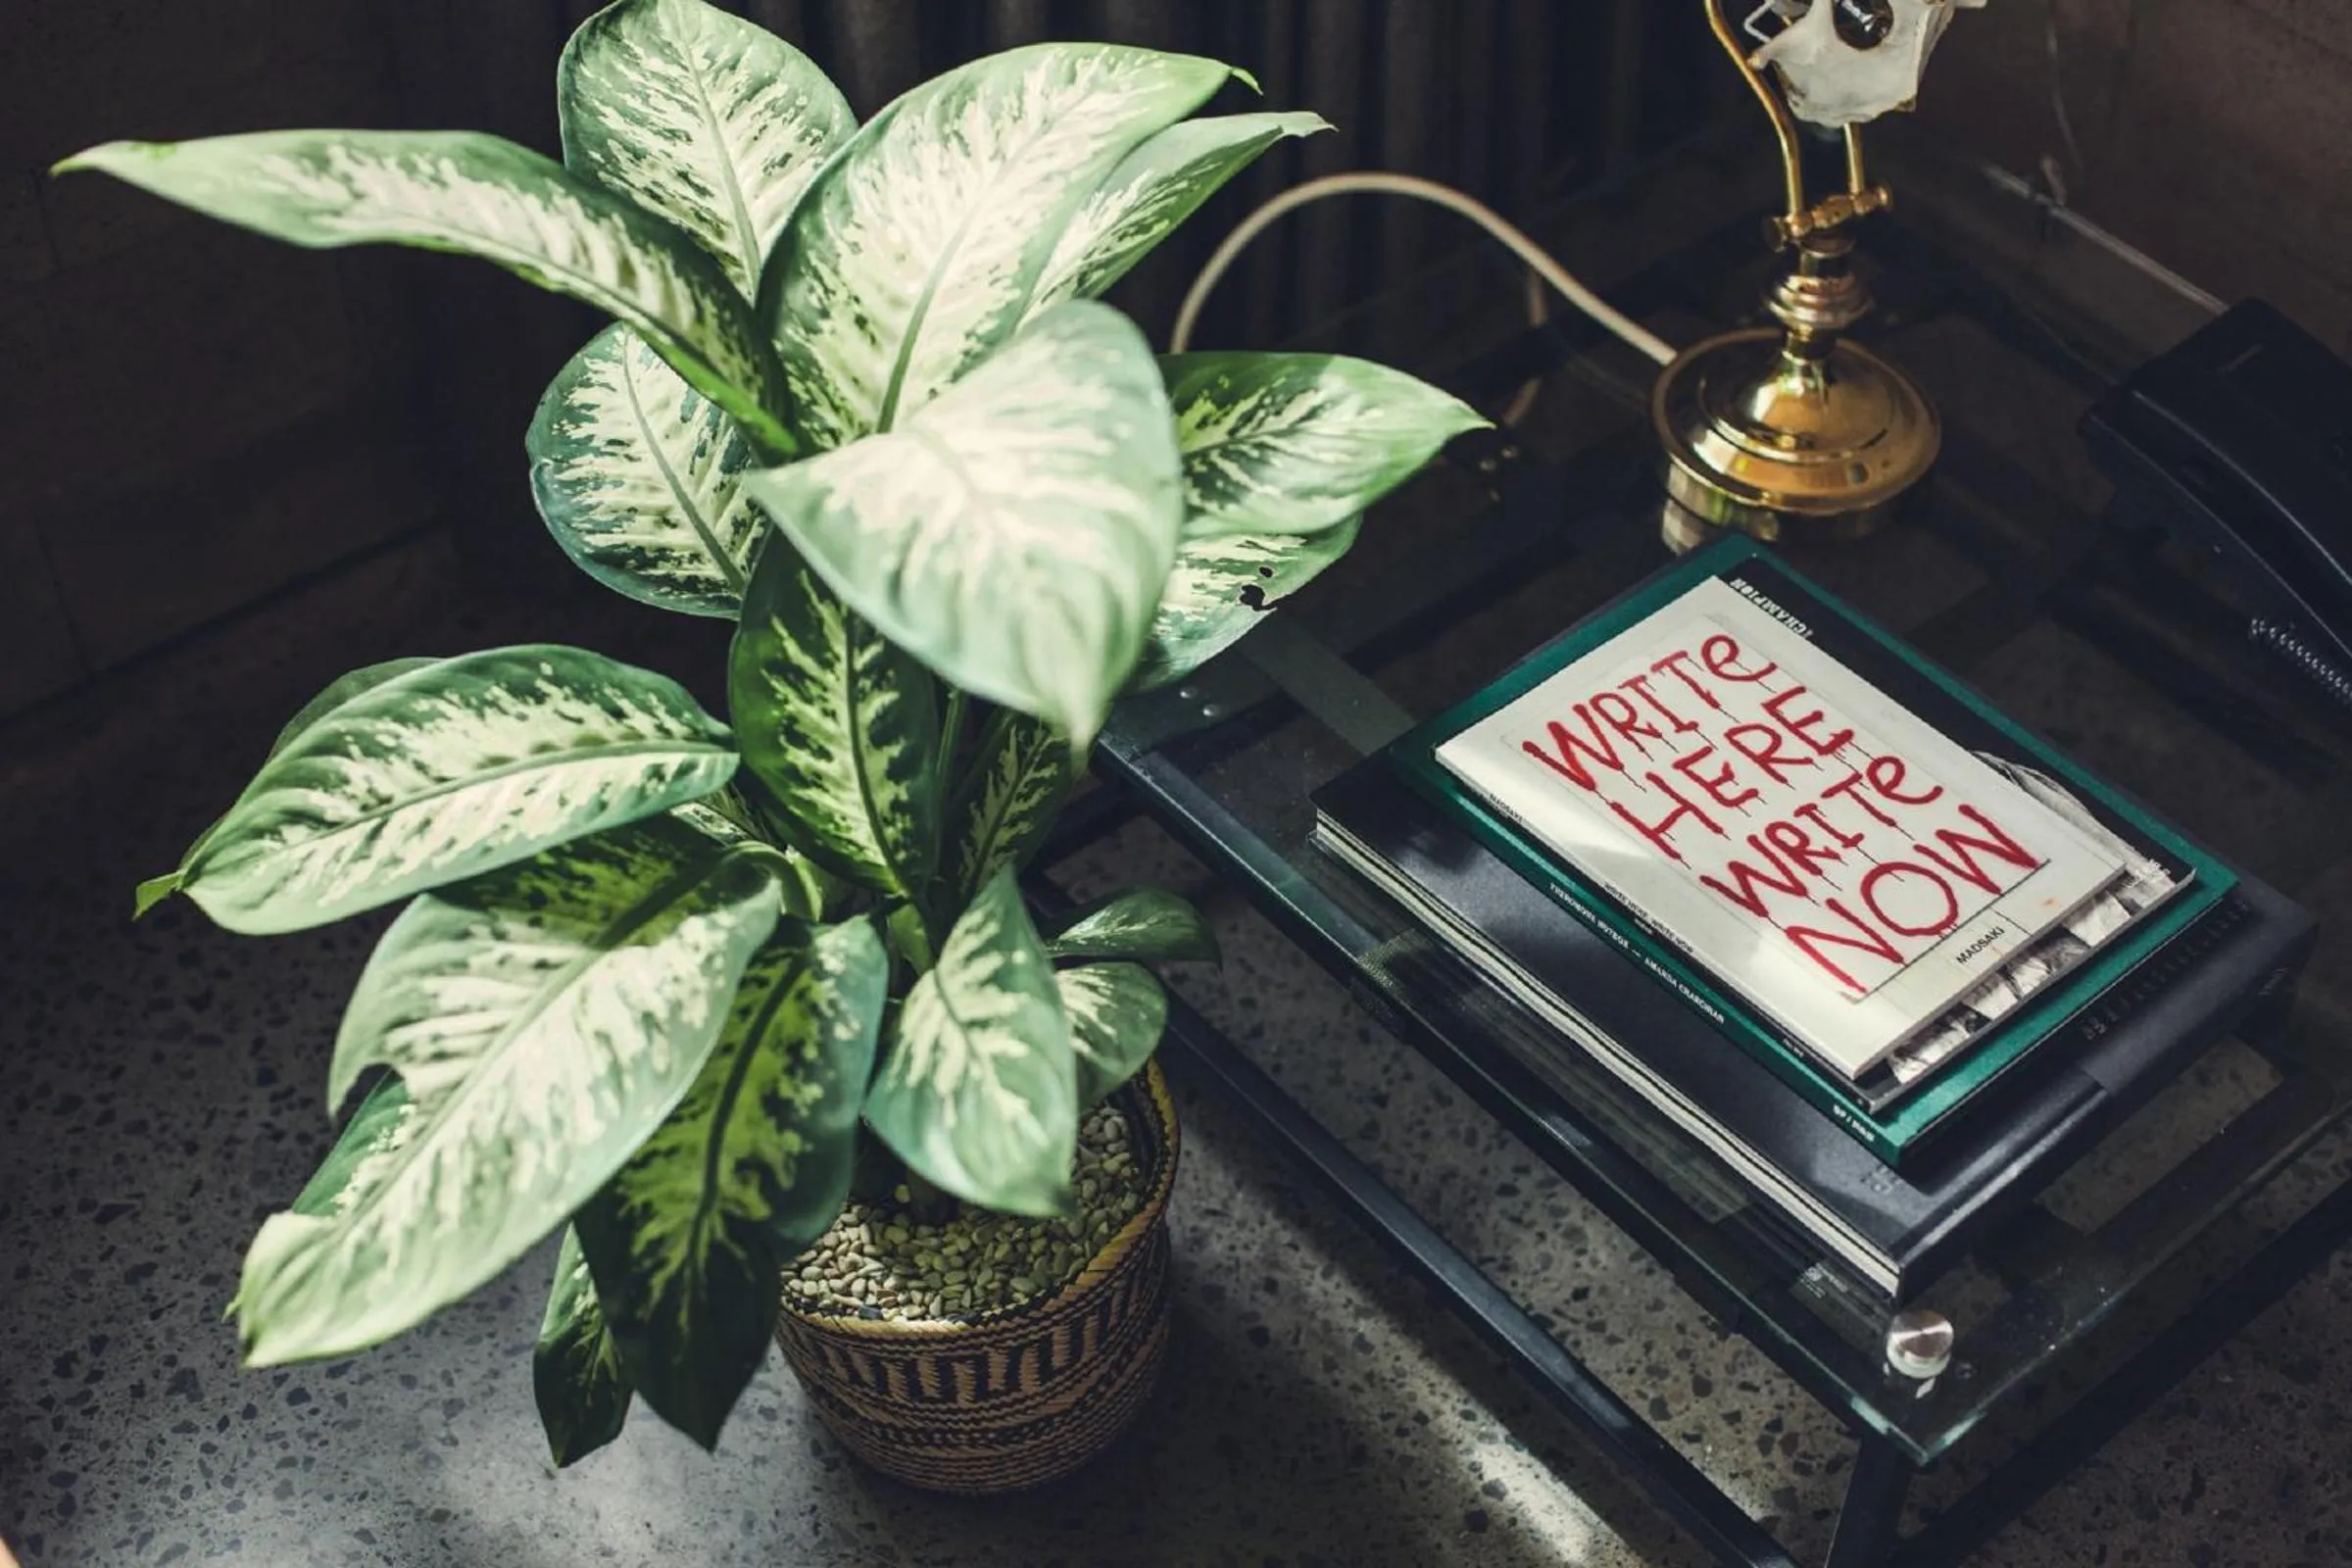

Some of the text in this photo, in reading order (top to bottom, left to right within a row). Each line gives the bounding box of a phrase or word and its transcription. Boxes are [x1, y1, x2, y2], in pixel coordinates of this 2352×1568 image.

[1609, 686, 1854, 859] HERE
[1786, 804, 2041, 994] NOW
[1955, 925, 2005, 964] MADSAKI
